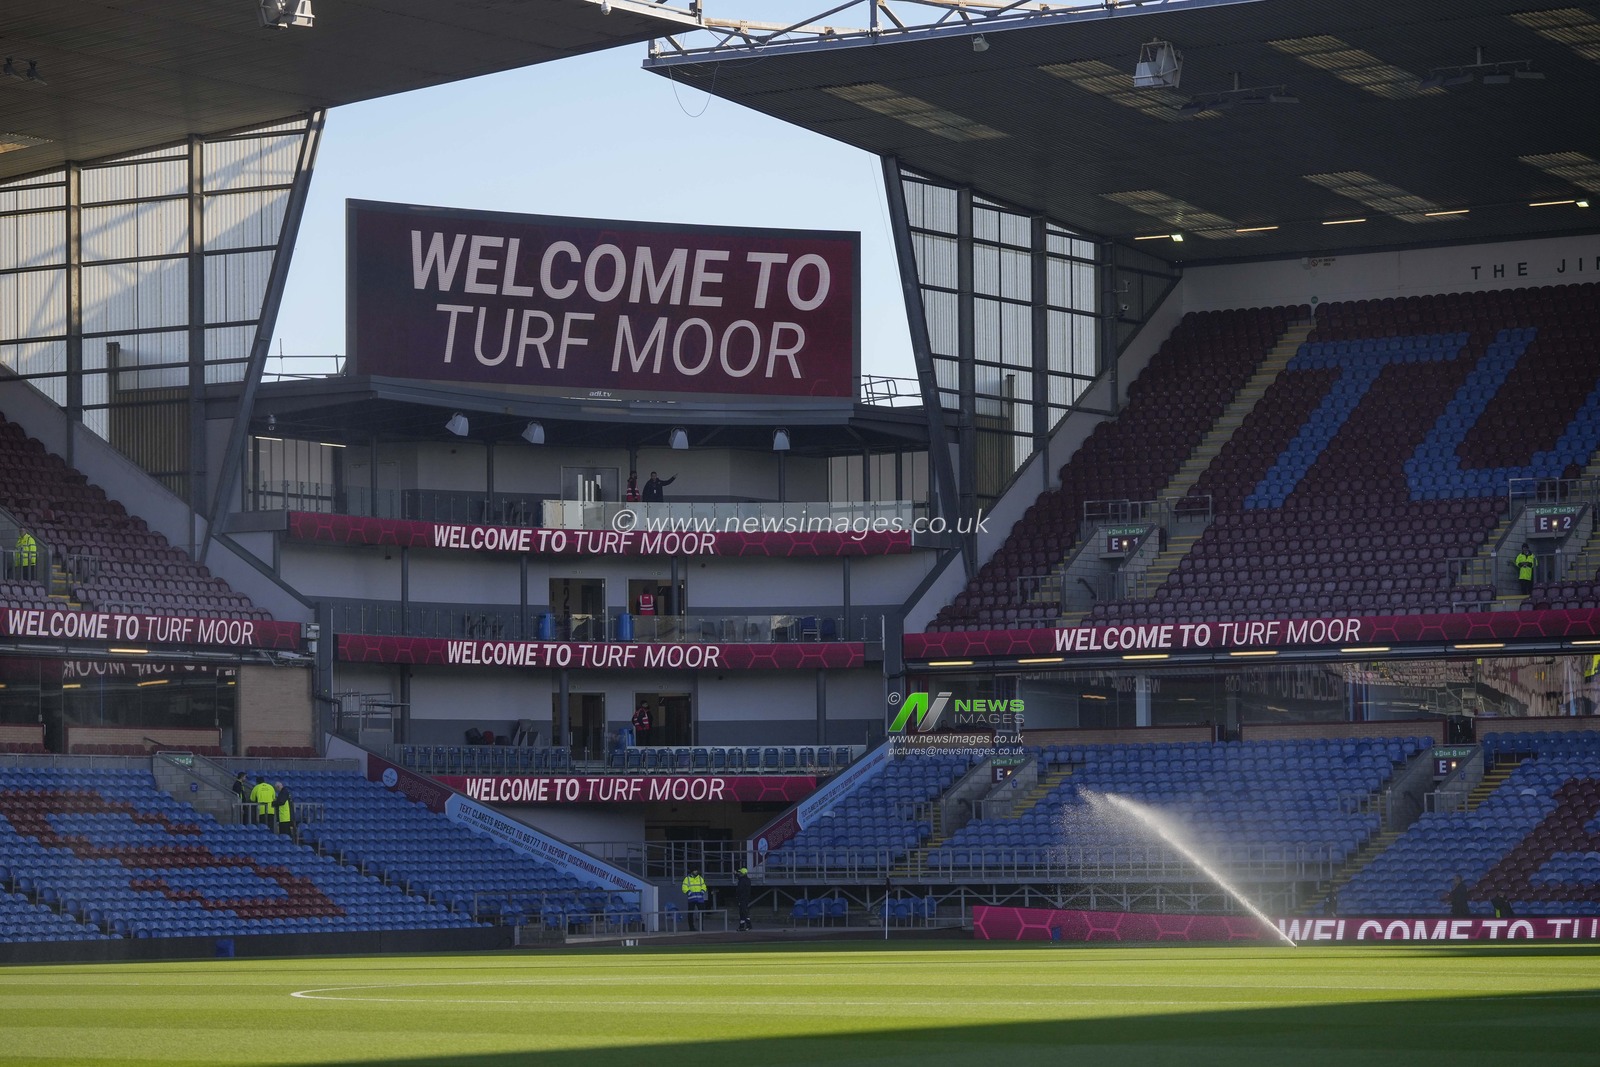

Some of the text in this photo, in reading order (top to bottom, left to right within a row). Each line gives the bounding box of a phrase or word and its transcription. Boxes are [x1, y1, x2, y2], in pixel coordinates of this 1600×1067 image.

[411, 230, 831, 311] WELCOME TO
[1471, 262, 1528, 280] THE
[436, 303, 806, 379] TURF MOOR
[1540, 517, 1571, 530] E 2
[434, 524, 716, 555] WELCOME TO TURF MOOR
[1112, 538, 1118, 550] E
[8, 609, 254, 645] WELCOME TO TURF MOOR
[1055, 618, 1361, 652] WELCOME TO TURF MOOR
[447, 640, 720, 668] WELCOME TO TURF MOOR
[996, 768, 1004, 780] E
[1439, 760, 1447, 773] E
[466, 778, 725, 802] WELCOME TO TURF MOOR
[460, 803, 474, 815] TEXT
[472, 808, 495, 826] CLARETS
[494, 818, 516, 836] RESPECT
[548, 846, 568, 860] REPORT
[568, 854, 610, 880] DISCRIMINATORY
